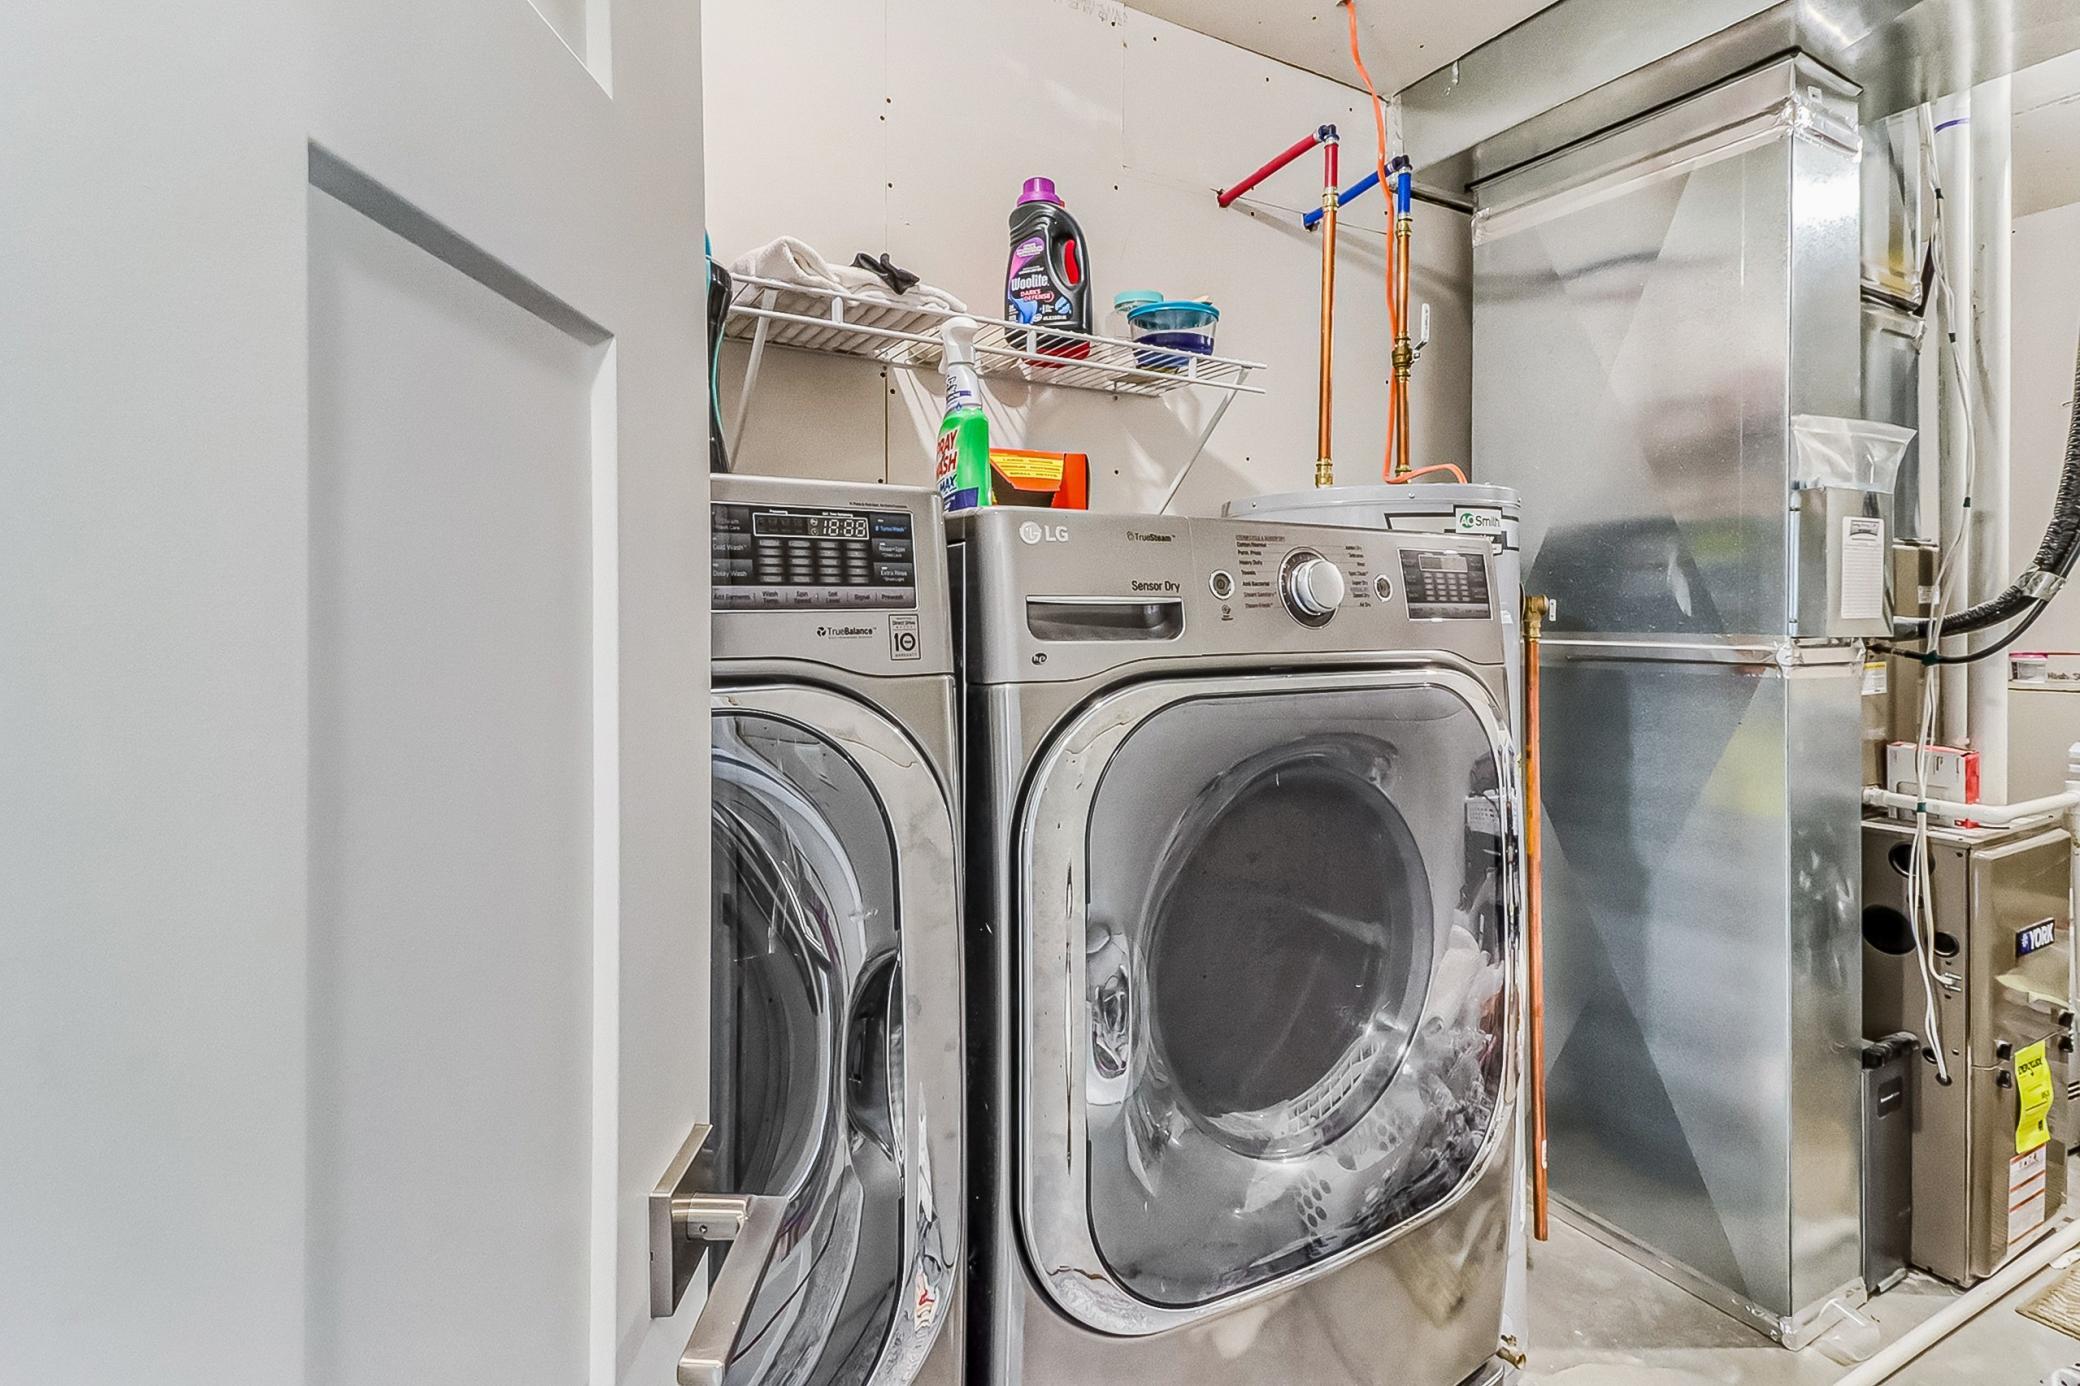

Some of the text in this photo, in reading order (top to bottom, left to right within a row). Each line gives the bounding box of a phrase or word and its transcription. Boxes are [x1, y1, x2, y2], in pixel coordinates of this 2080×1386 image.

[1011, 274, 1048, 291] Woolite
[823, 519, 866, 537] 18:88
[1475, 515, 1501, 528] Smith
[1044, 525, 1069, 542] LG
[1131, 580, 1181, 593] Sensor Dry
[894, 632, 916, 652] 10
[2029, 922, 2054, 950] YORK
